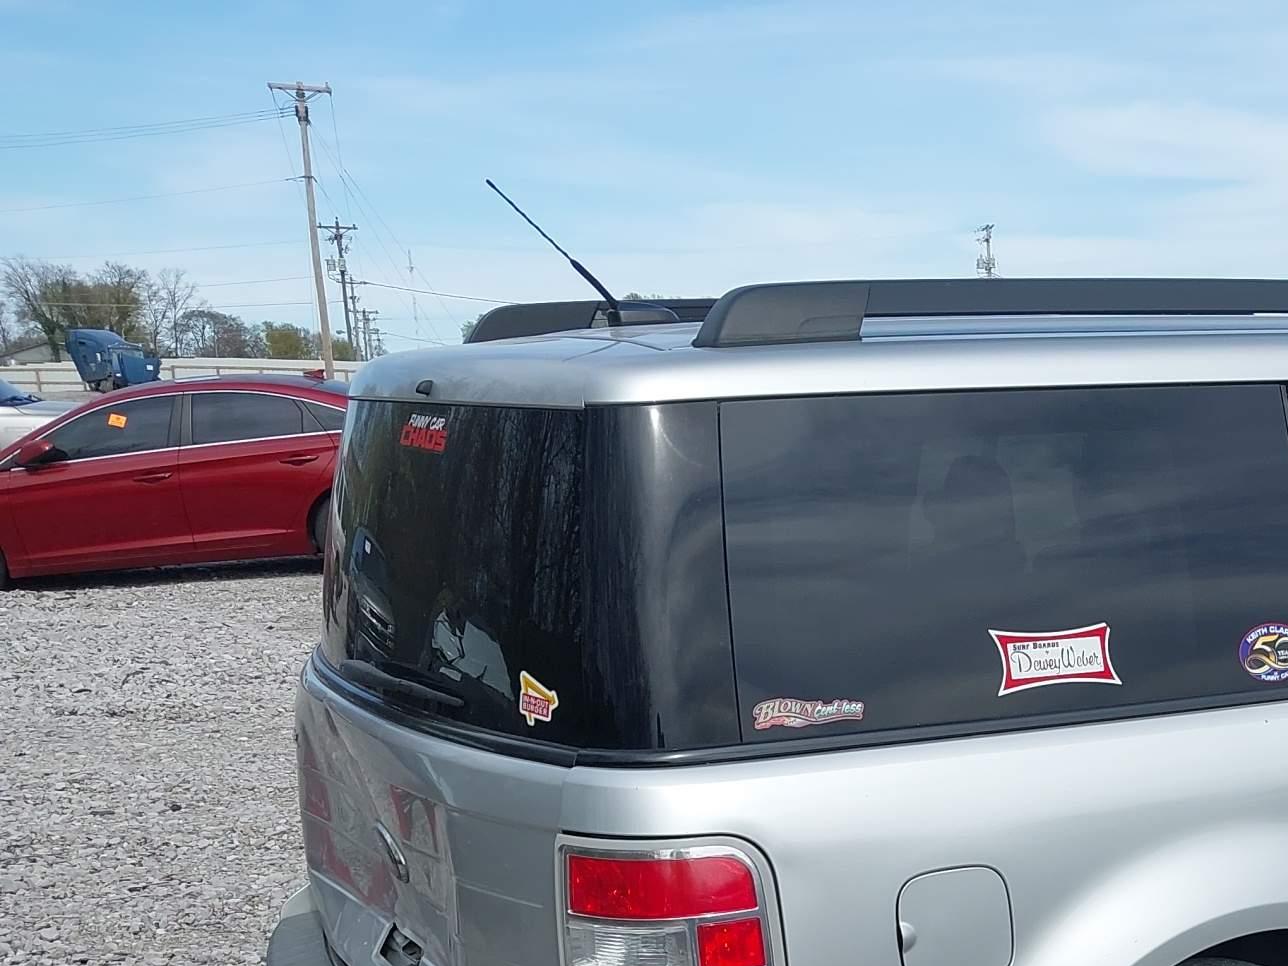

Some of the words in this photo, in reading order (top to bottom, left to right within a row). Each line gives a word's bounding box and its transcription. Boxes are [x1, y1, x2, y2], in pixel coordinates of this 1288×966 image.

[430, 416, 446, 431] CAR
[400, 425, 447, 452] CHAOS
[1246, 627, 1268, 643] KEITH
[1011, 650, 1060, 674] Dewey
[1061, 645, 1101, 668] Weber
